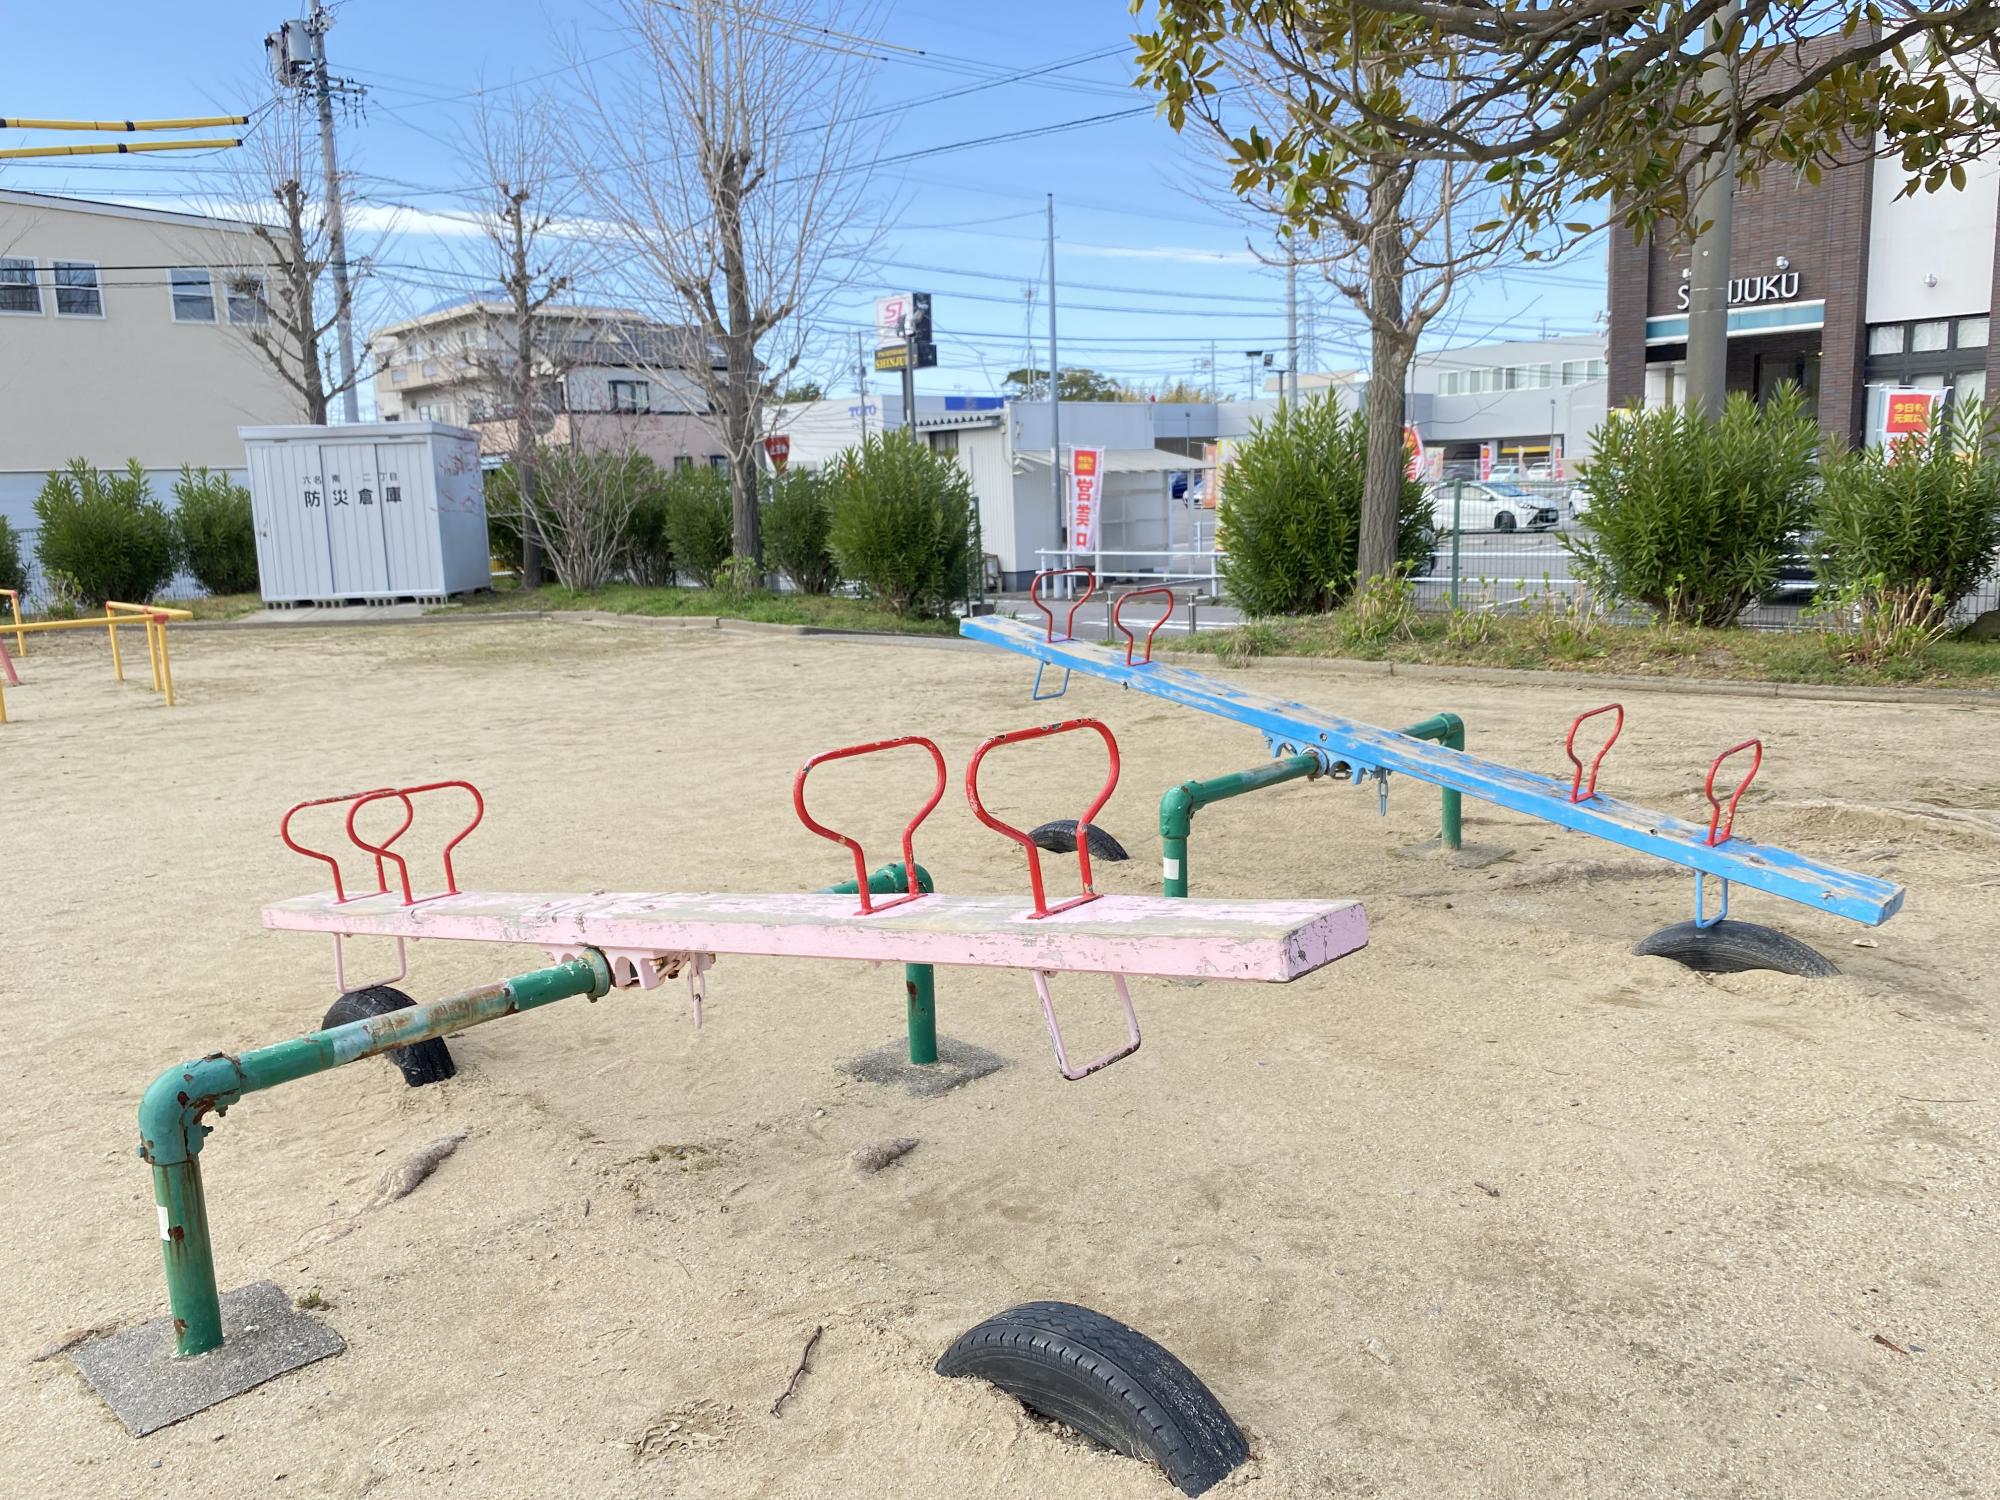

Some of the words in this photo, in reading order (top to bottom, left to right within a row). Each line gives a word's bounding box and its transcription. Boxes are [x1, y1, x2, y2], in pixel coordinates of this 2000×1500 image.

[1676, 272, 1800, 310] SJUKU
[304, 486, 402, 508] 防災倉庫
